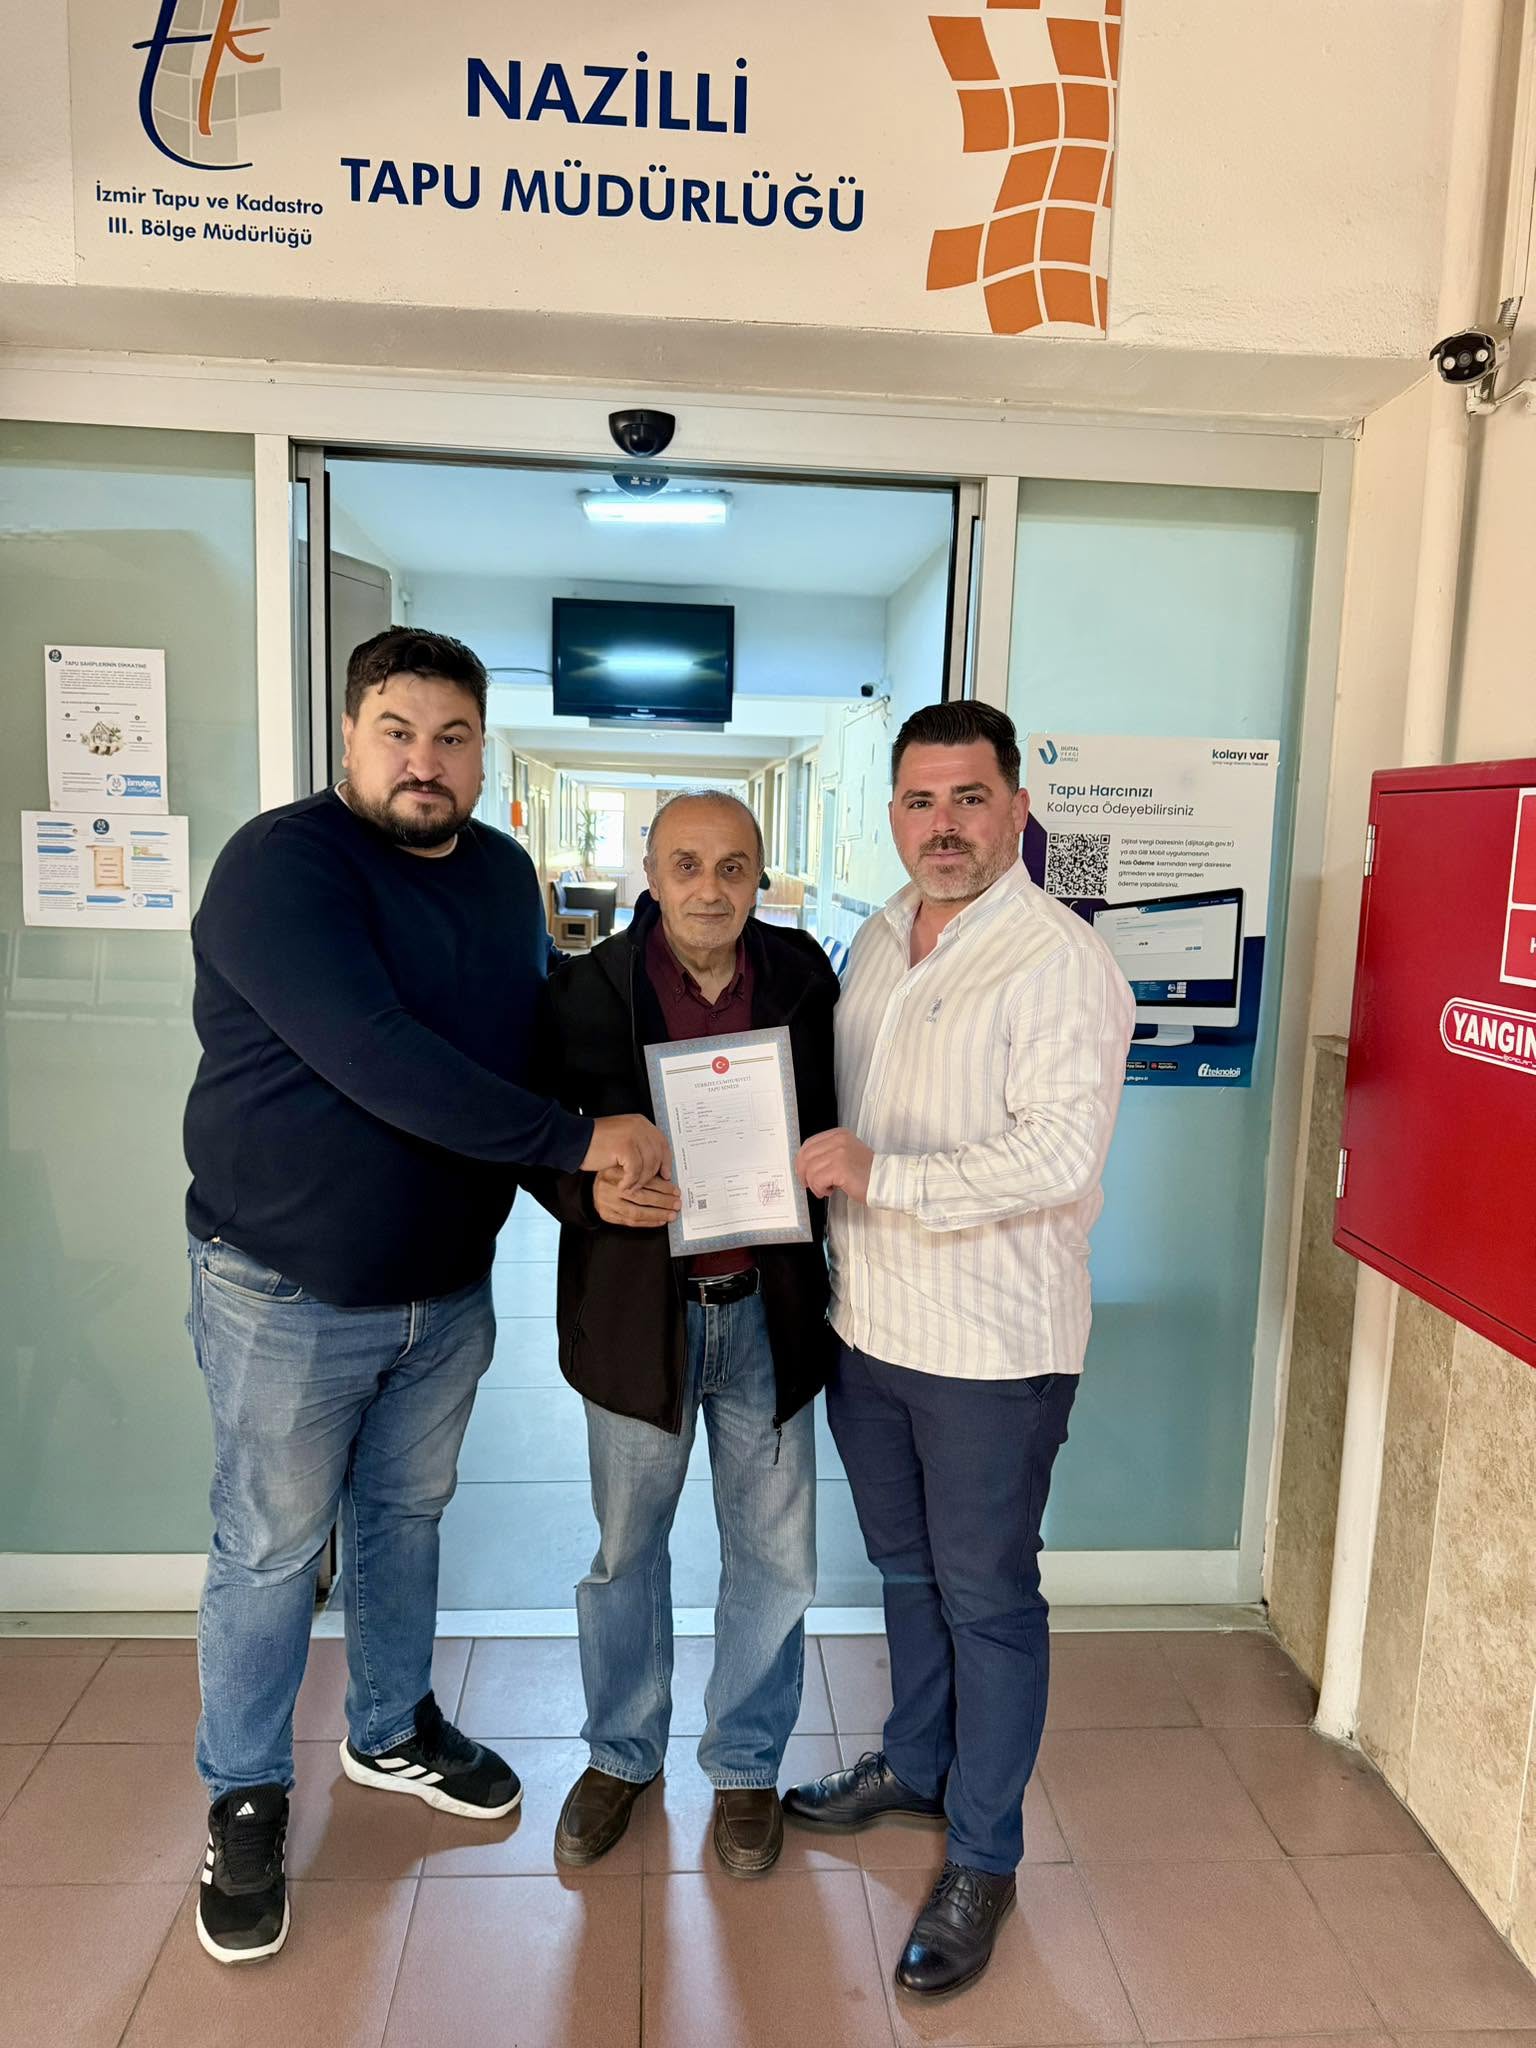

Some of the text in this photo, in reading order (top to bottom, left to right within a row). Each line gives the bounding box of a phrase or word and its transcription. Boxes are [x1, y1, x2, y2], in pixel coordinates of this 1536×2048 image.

[467, 51, 748, 134] NAZİLLİ
[96, 180, 324, 215] İzmir Tapu ve Kadastro
[340, 157, 865, 232] TAPU MÜDÜRLÜĞÜ
[108, 217, 312, 248] III. Bölge Müdürlüğü
[1212, 749, 1269, 761] kolayı var
[1048, 783, 1153, 799] Tapu Harcınızı
[1047, 801, 1194, 818] Kolayca Ödeyebilirsiniz
[1453, 1010, 1536, 1060] YANGIN
